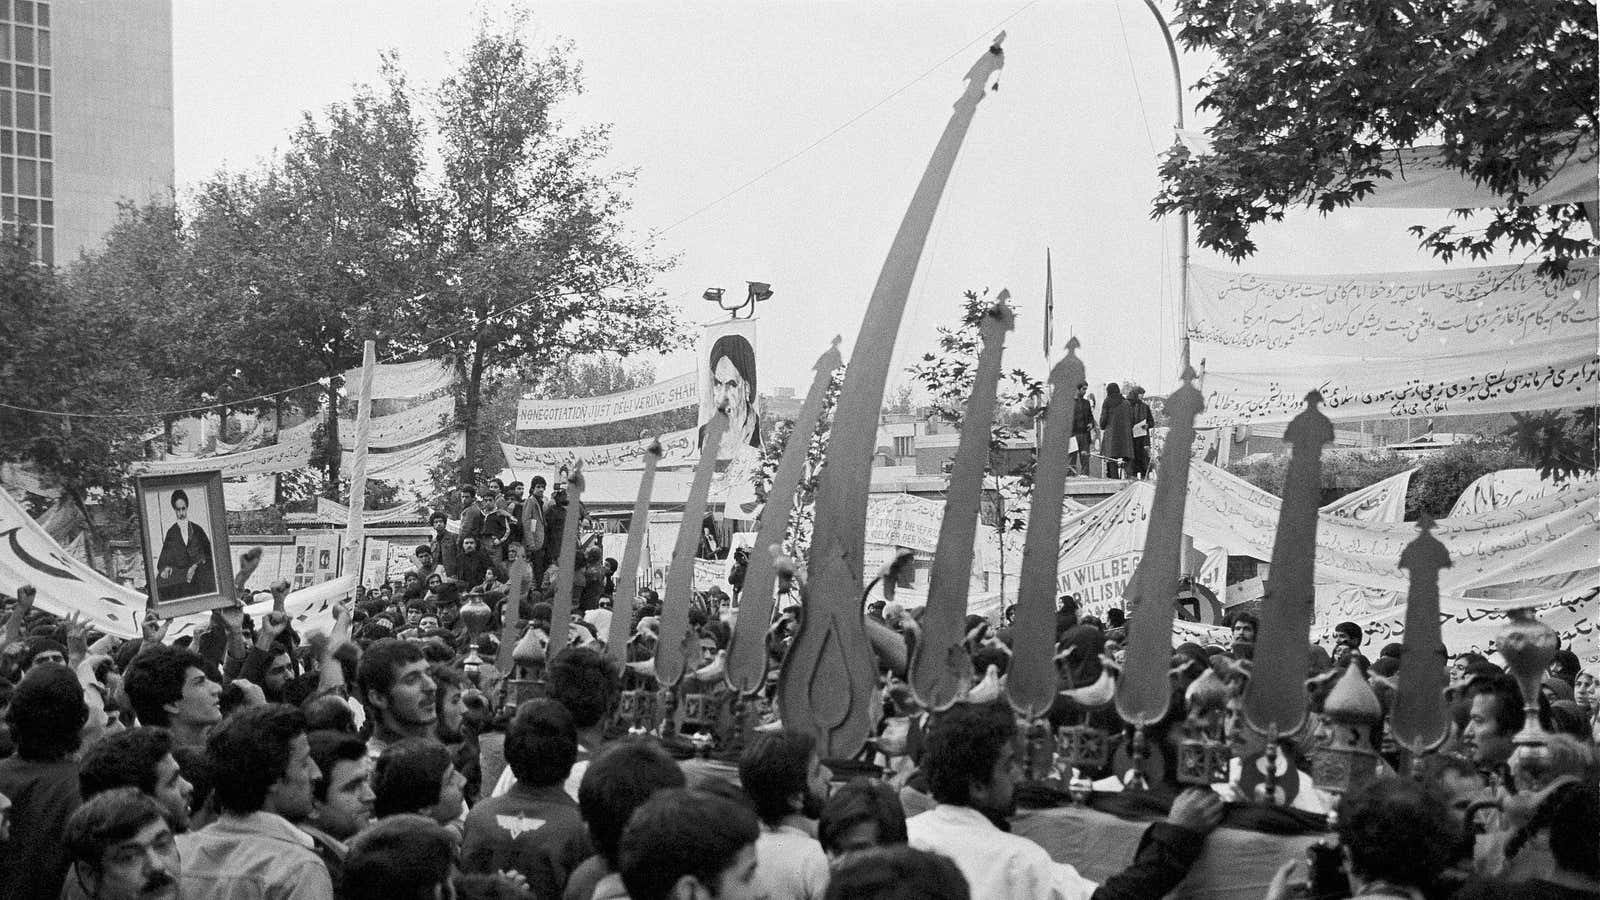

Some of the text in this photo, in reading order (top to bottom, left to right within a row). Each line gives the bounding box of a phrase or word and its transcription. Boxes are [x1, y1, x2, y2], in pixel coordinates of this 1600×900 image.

[1300, 284, 1328, 298] است
[1343, 283, 1366, 306] امام
[1368, 280, 1386, 299] خط
[1385, 284, 1406, 308] پیرو
[1405, 281, 1445, 301] مسلمان
[1436, 313, 1468, 331] است
[1521, 304, 1551, 340] گام
[1549, 301, 1579, 335] گام
[1569, 309, 1598, 324] ست
[1446, 375, 1479, 403] نیروی
[1504, 364, 1555, 394] فرماندهی
[588, 403, 611, 418] JUST
[613, 391, 665, 415] DELIVERING
[668, 383, 697, 402] SHAH
[1074, 562, 1110, 586] WILL
[1111, 557, 1130, 577] BE
